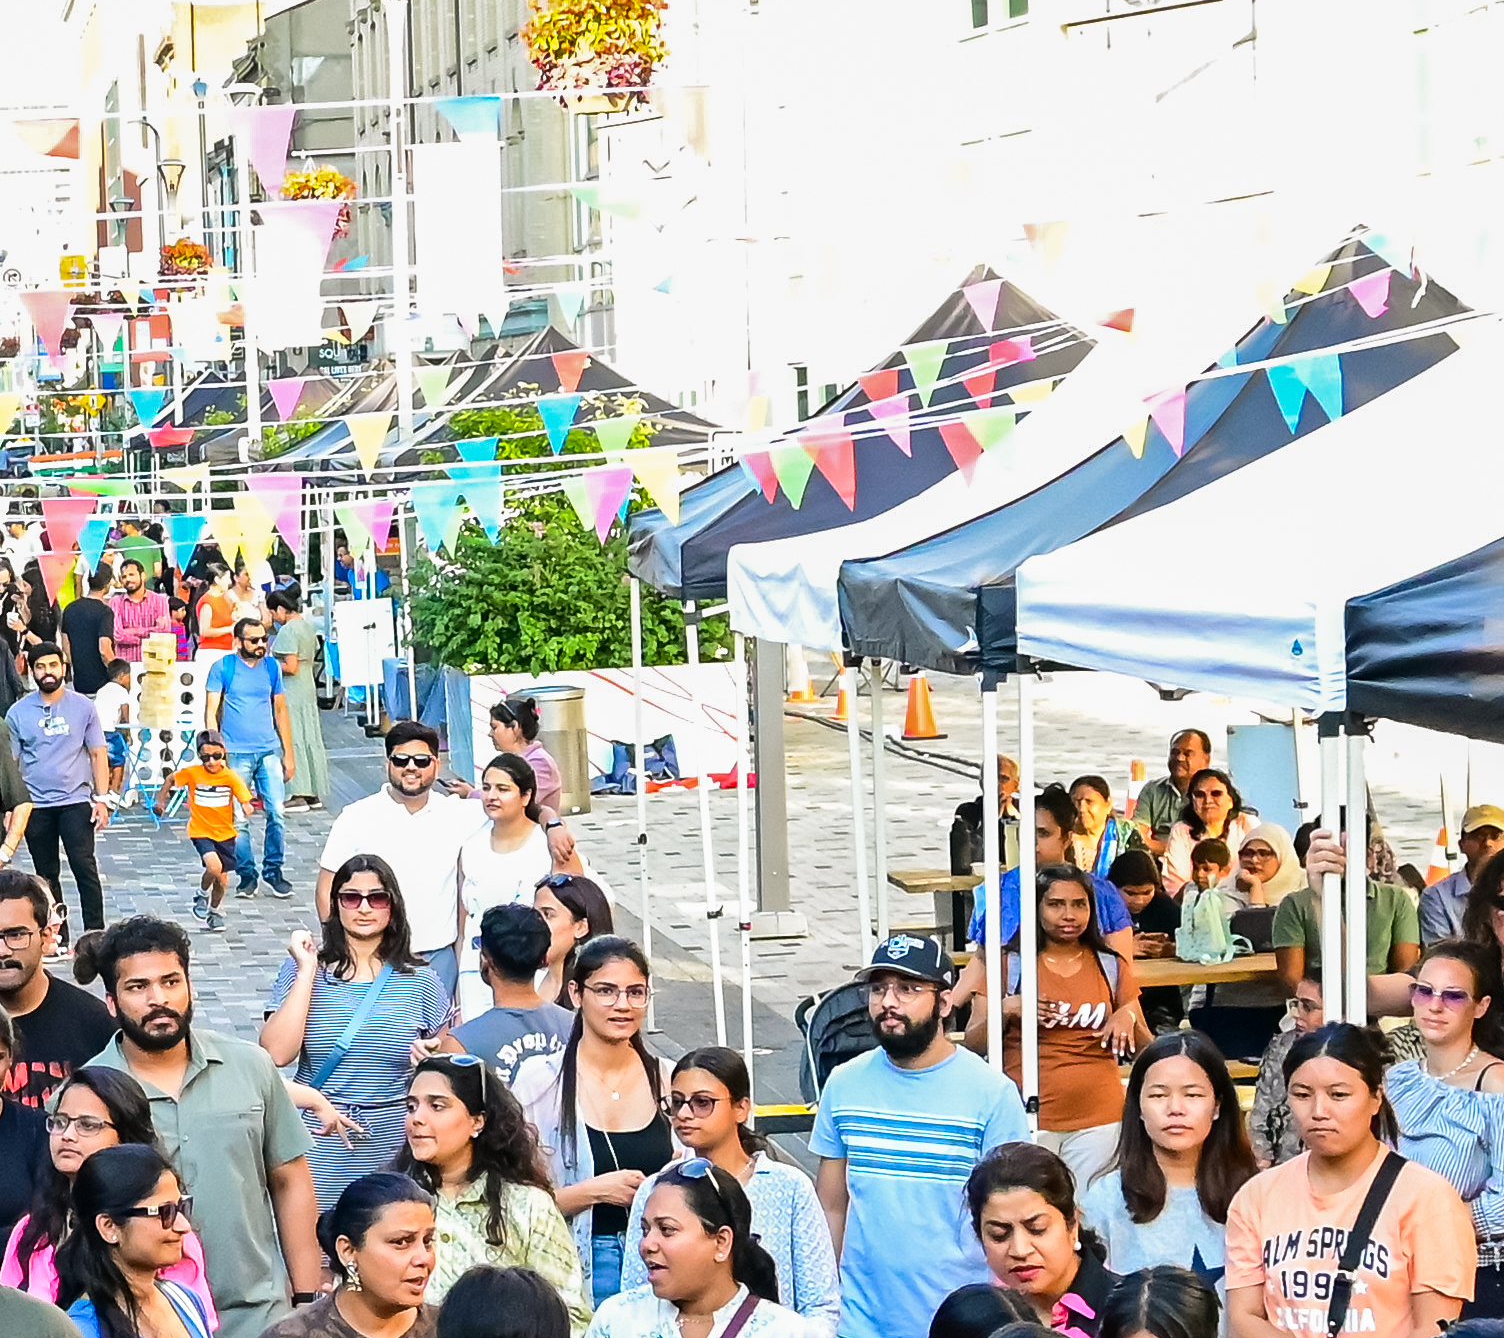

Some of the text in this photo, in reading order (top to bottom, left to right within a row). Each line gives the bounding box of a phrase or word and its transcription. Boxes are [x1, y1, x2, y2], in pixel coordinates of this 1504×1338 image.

[1263, 1226, 1390, 1279] ALM SPRGS
[1280, 1270, 1333, 1300] 199
